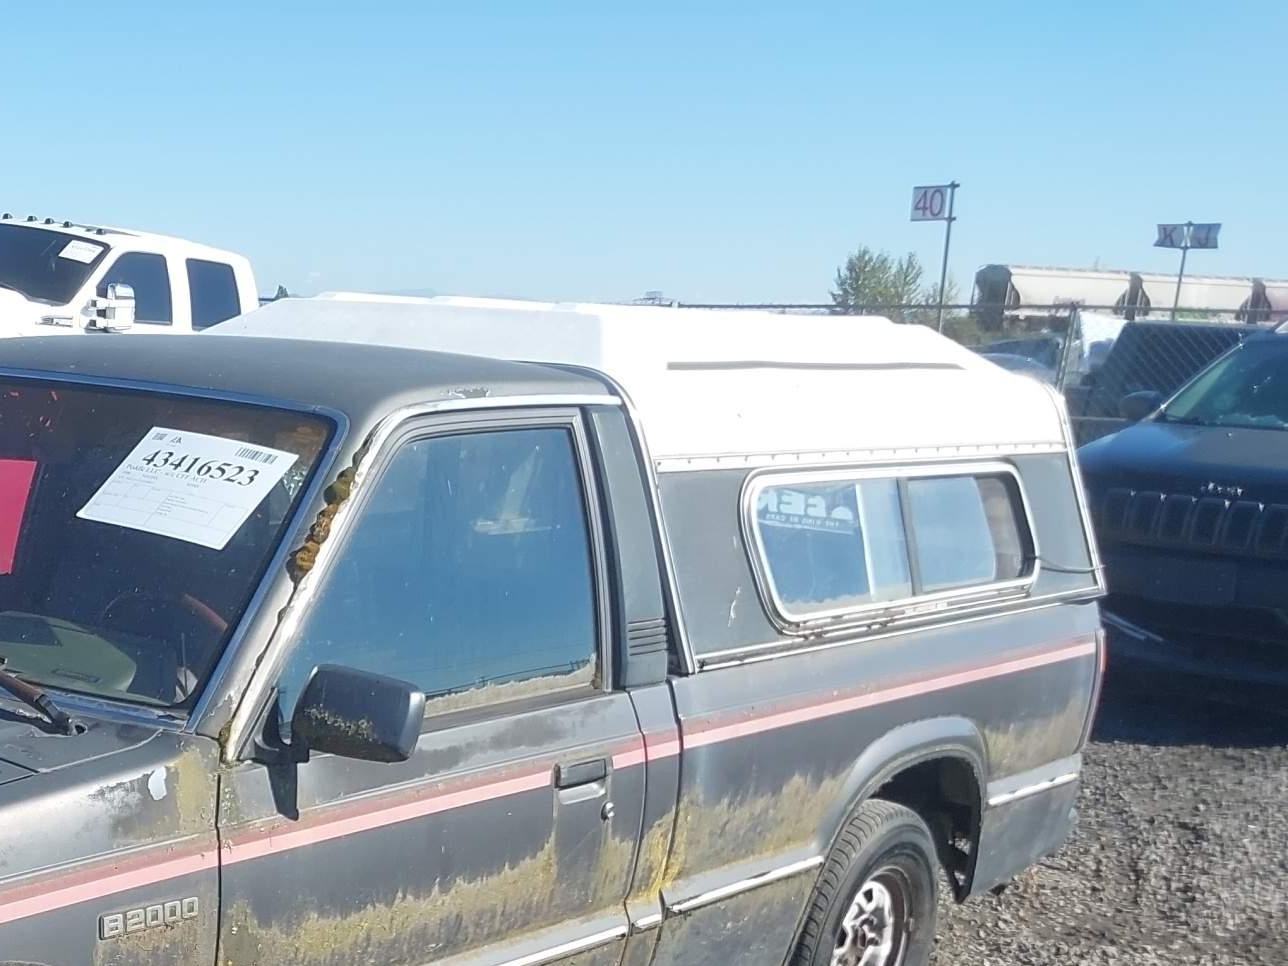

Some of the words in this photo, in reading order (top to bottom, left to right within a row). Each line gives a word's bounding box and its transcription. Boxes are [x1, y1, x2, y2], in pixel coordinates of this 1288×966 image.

[913, 188, 945, 217] 40
[1160, 226, 1177, 246] K
[142, 449, 260, 487] 43416523
[103, 896, 199, 938] B2000
